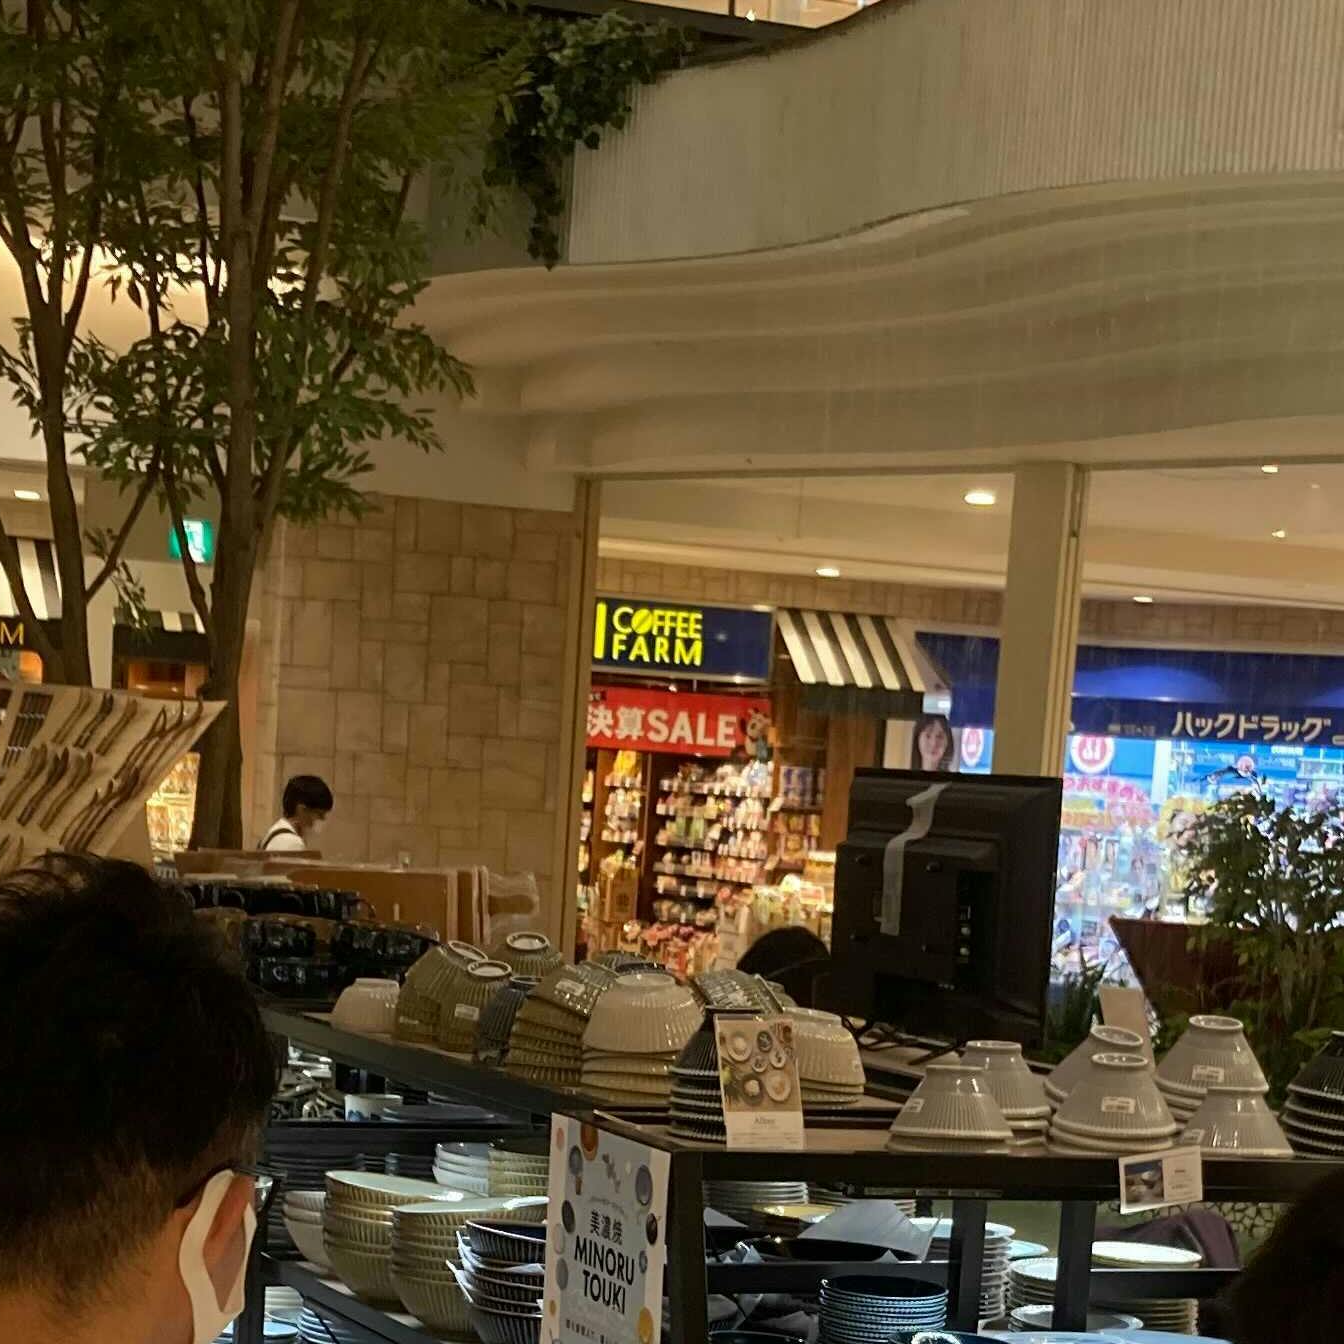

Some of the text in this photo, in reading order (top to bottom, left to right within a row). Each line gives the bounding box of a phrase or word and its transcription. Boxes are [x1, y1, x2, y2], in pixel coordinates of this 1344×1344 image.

[613, 606, 703, 639] COFFEE
[612, 633, 703, 668] FARM
[1171, 711, 1332, 743] ハックドラッグ
[589, 1208, 623, 1246] 美濃焼
[574, 1235, 635, 1286] MINORU
[582, 1269, 626, 1315] TOUKI
